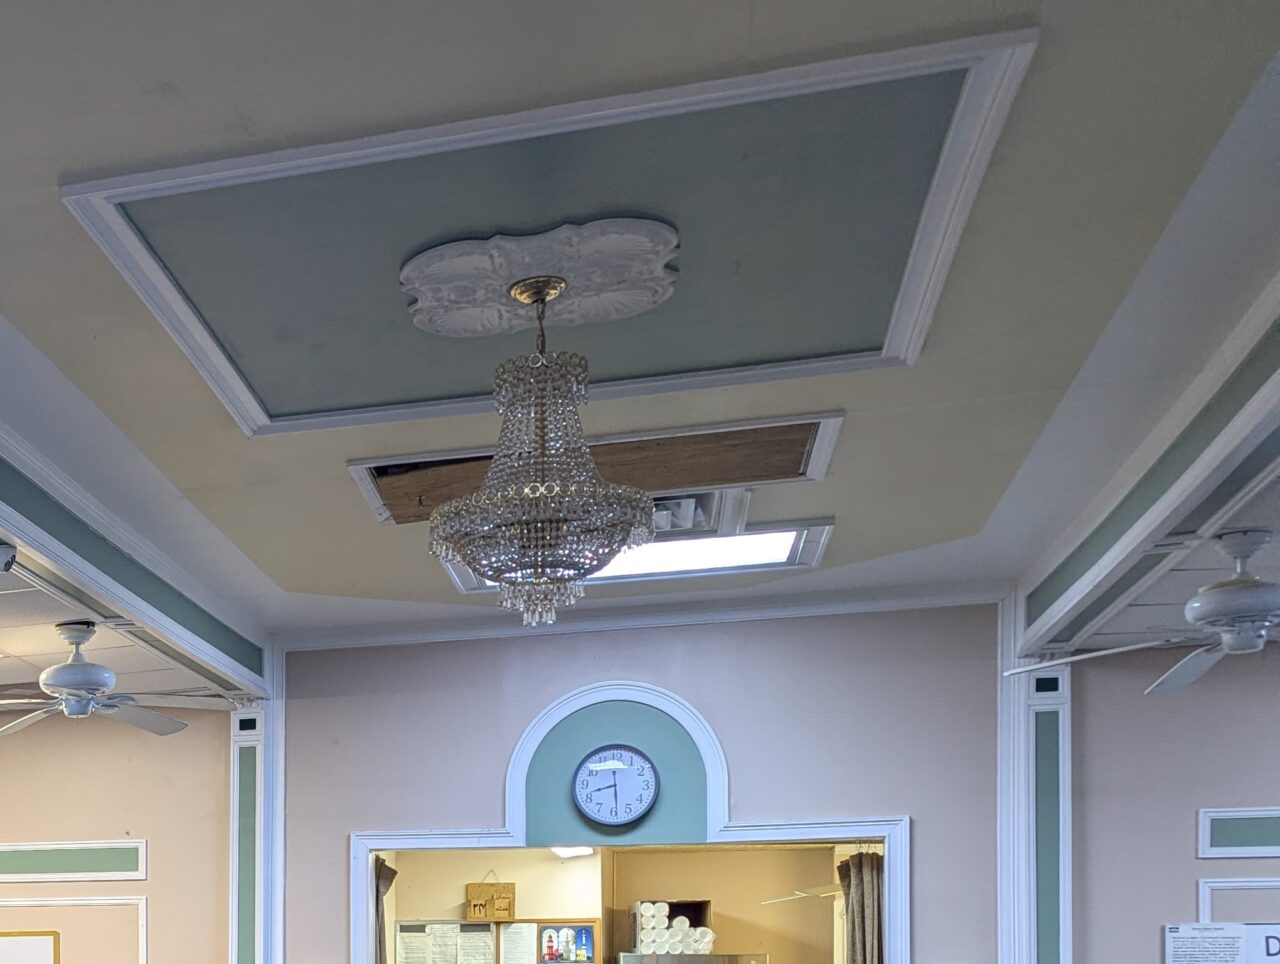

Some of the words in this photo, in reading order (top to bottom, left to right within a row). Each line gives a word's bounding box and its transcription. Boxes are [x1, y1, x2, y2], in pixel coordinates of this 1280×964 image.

[637, 766, 645, 776] 2
[581, 779, 589, 790] 9
[642, 780, 650, 791] 3
[585, 793, 593, 804] 8
[624, 804, 632, 815] 5
